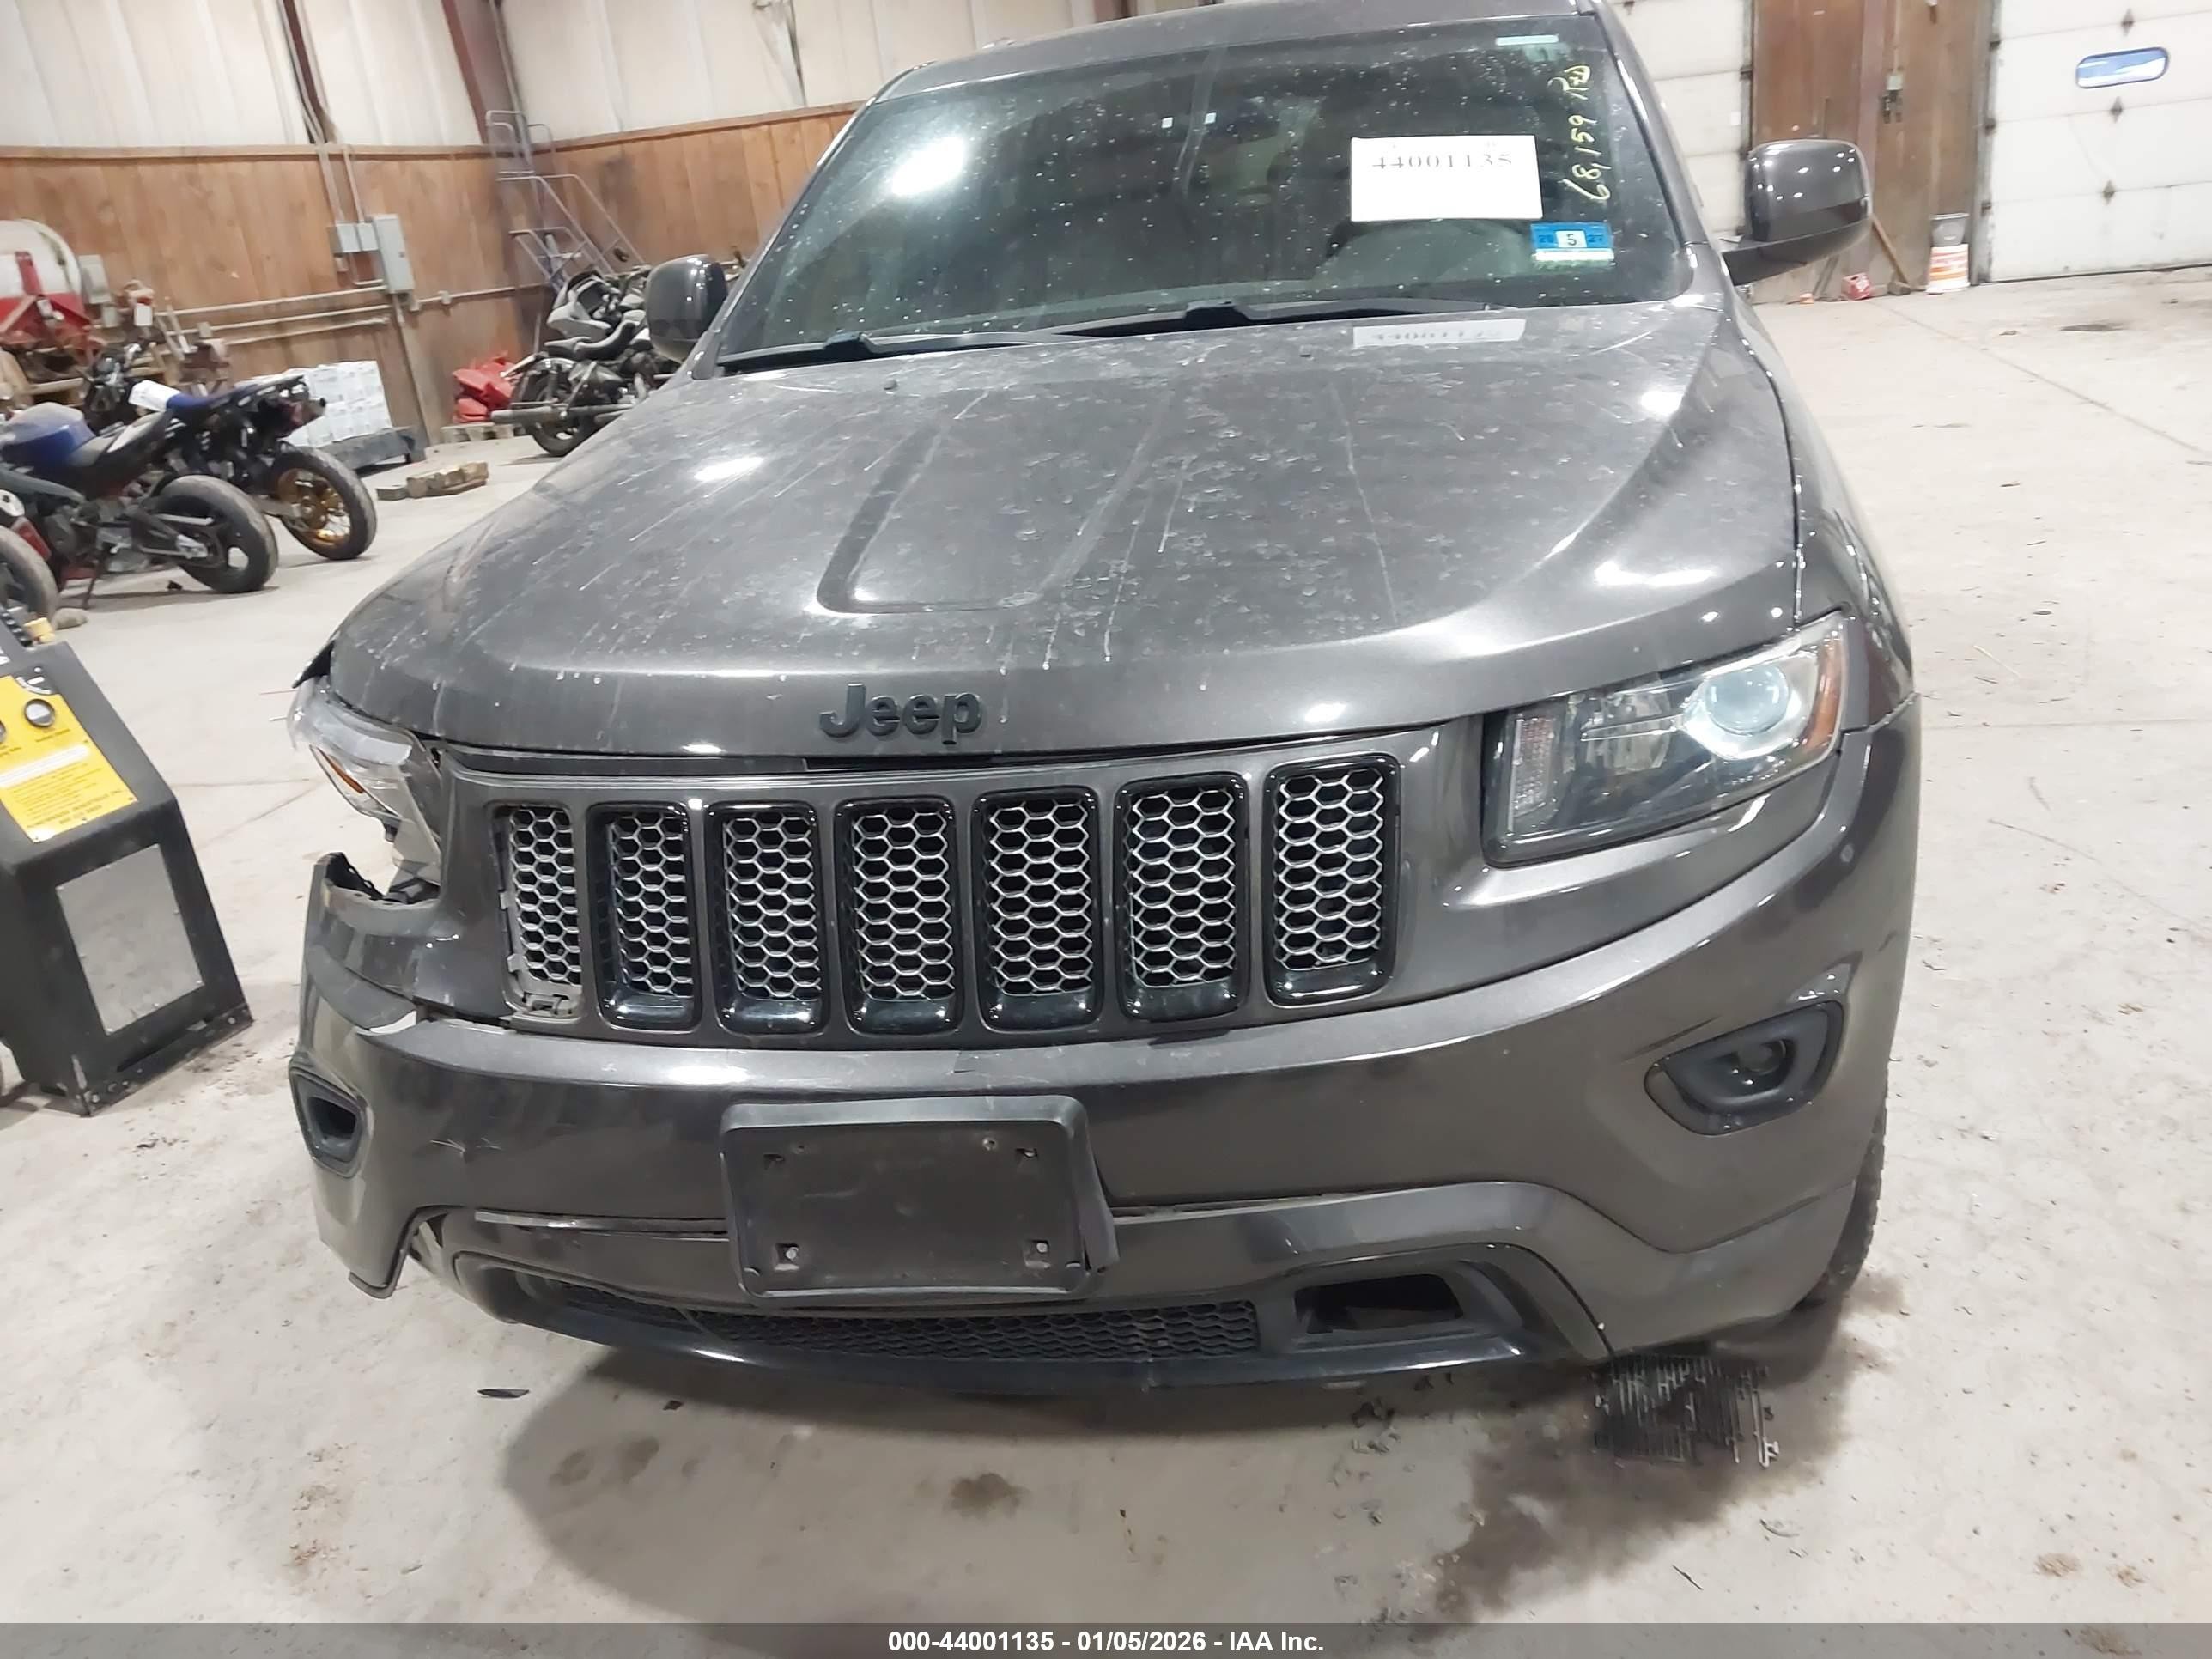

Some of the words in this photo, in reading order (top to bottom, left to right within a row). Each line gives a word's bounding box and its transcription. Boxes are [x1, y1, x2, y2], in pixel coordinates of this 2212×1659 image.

[1557, 114, 1612, 200] 68,159
[1565, 233, 1577, 246] 5
[818, 682, 981, 745] Jeep
